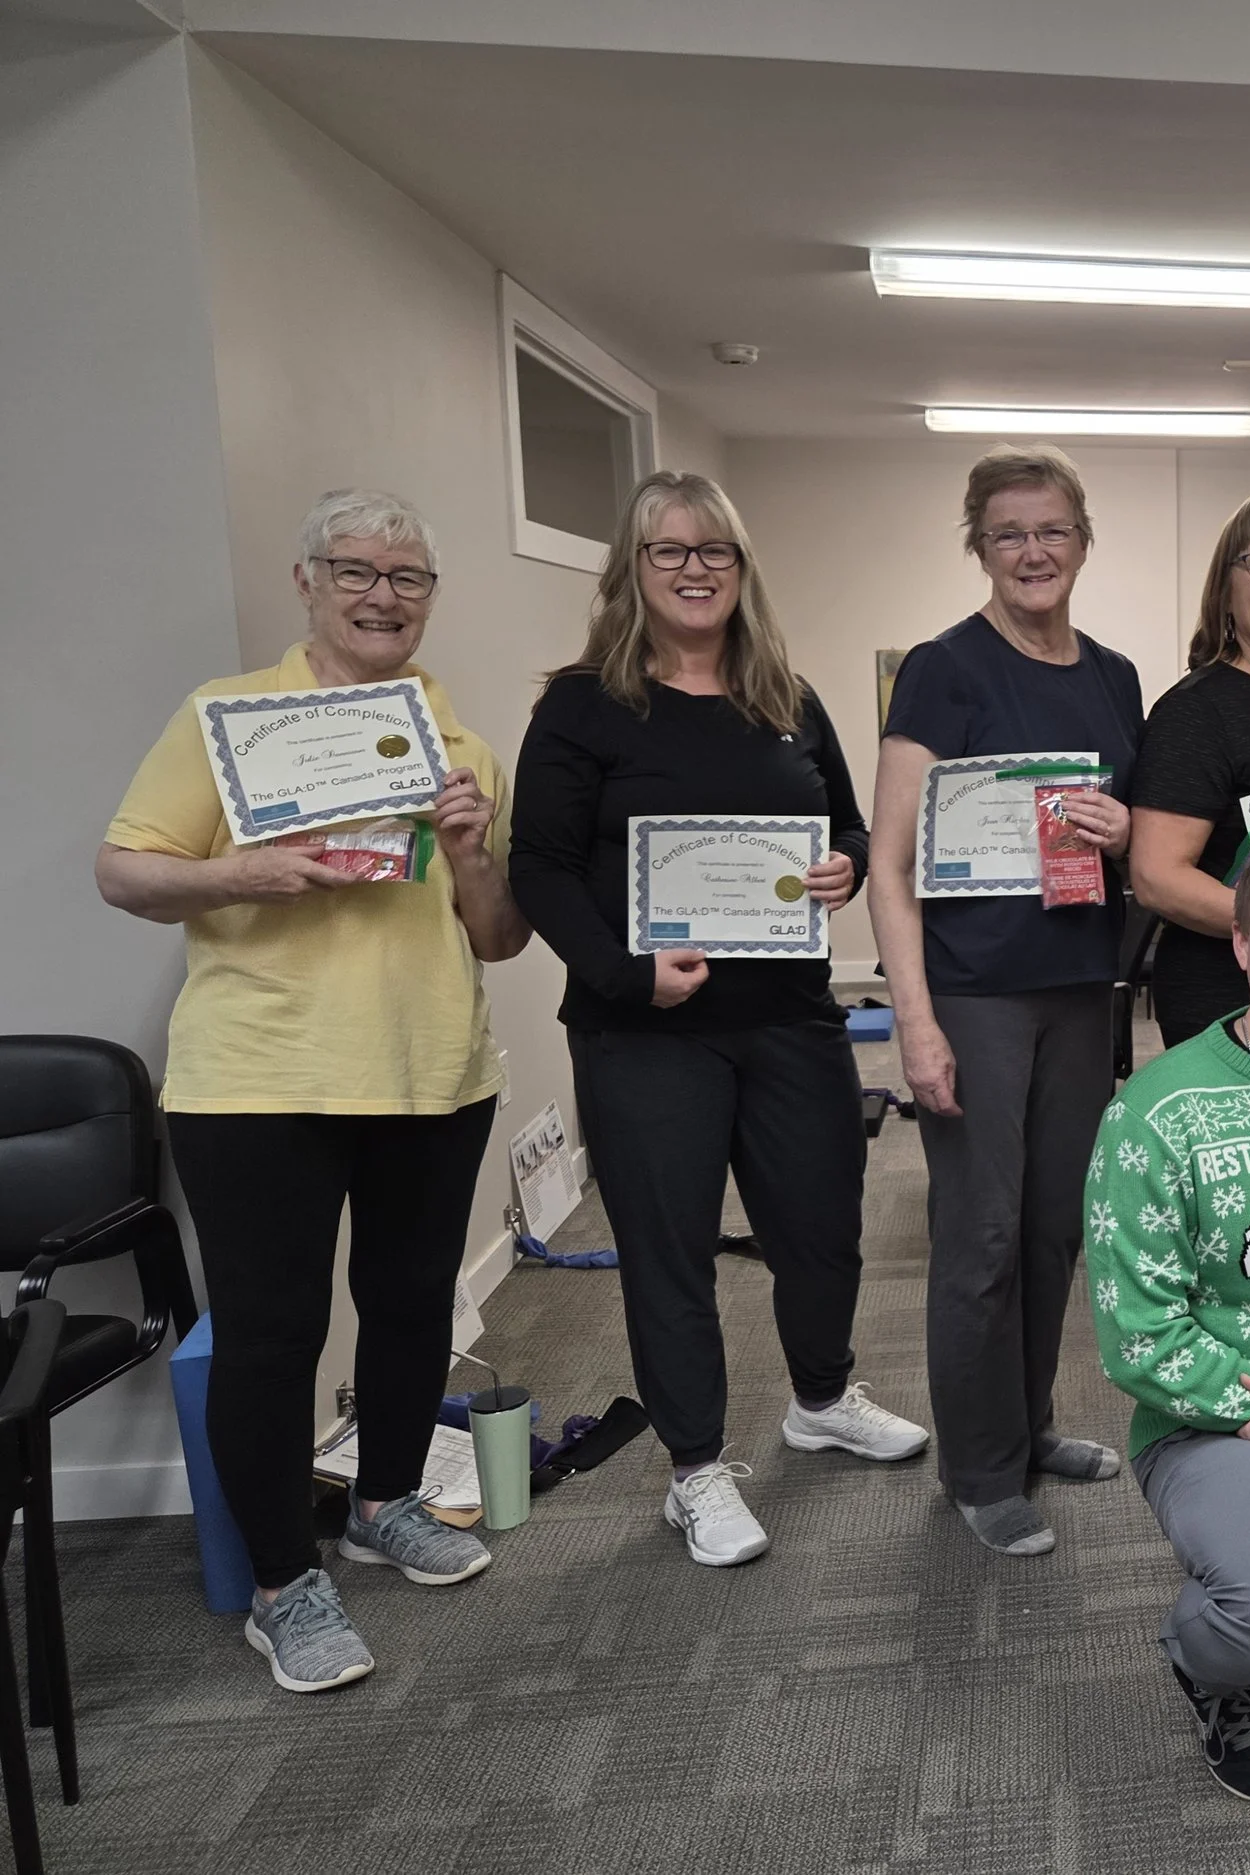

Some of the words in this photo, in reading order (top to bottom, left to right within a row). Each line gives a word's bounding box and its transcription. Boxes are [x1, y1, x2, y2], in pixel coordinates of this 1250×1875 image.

[234, 711, 301, 757] Certificate
[305, 707, 320, 719] of
[323, 705, 412, 730] Completion
[251, 791, 274, 803] The
[331, 771, 375, 787] Canada
[377, 762, 424, 778] Program
[389, 776, 432, 791] GLA:D
[938, 775, 996, 813] Certificate
[651, 835, 716, 871] Certificate
[720, 832, 735, 844] of
[738, 833, 808, 871] Completion
[938, 848, 956, 856] The
[1002, 846, 1037, 855] Canada
[653, 906, 673, 916] The
[723, 907, 761, 917] Canada
[763, 908, 805, 919] Program
[769, 925, 806, 935] GLA:D
